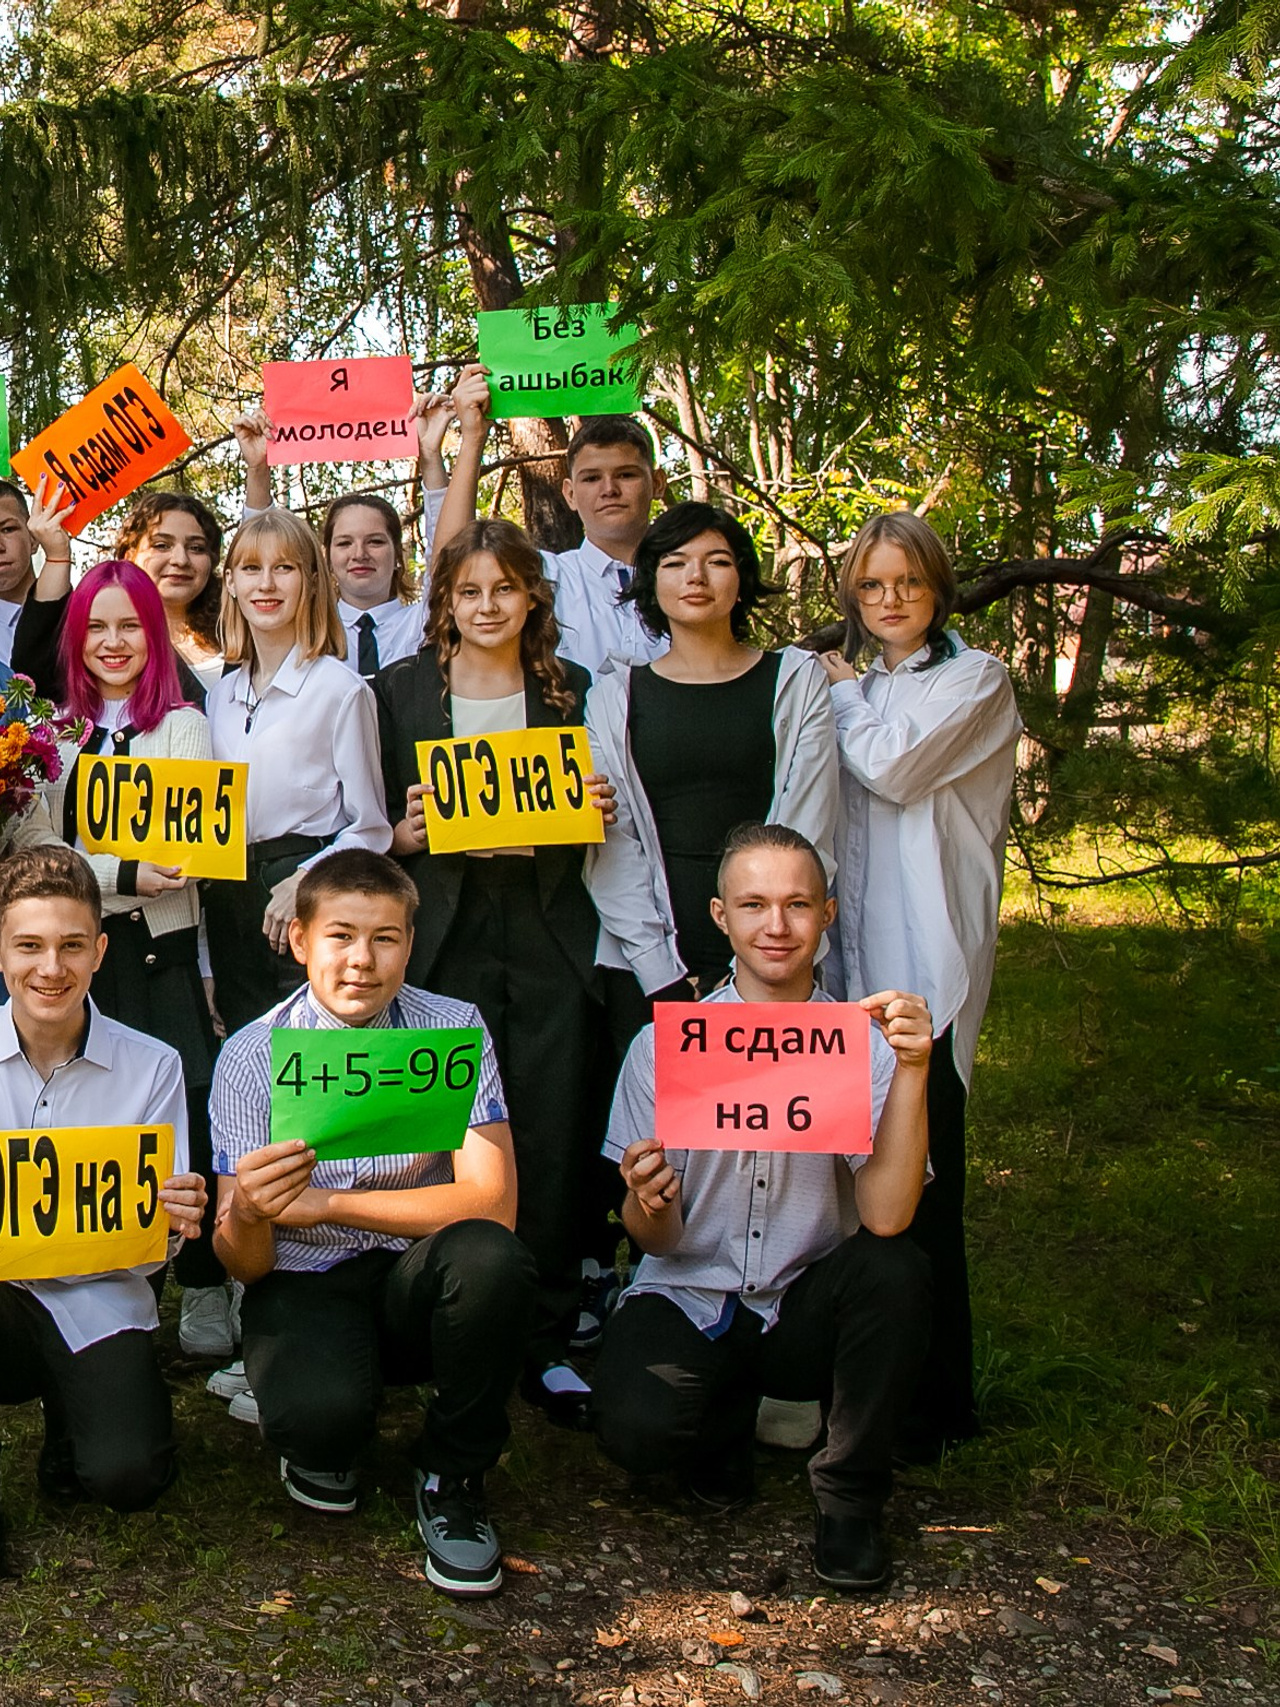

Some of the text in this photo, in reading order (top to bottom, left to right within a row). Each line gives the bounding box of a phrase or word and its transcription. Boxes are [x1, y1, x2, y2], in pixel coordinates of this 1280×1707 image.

[533, 316, 586, 341] Без
[330, 368, 348, 391] Я
[499, 362, 624, 392] ашыбак
[43, 386, 166, 504] Я сдам ОГЭ
[276, 419, 408, 442] молодец
[430, 733, 584, 820] ОГЭ на 5
[86, 761, 234, 846] ОГЭ на 5
[680, 1018, 845, 1062] Я сдам
[716, 1096, 811, 1132] на 6
[75, 1160, 123, 1234] на
[136, 1133, 159, 1229] 5
